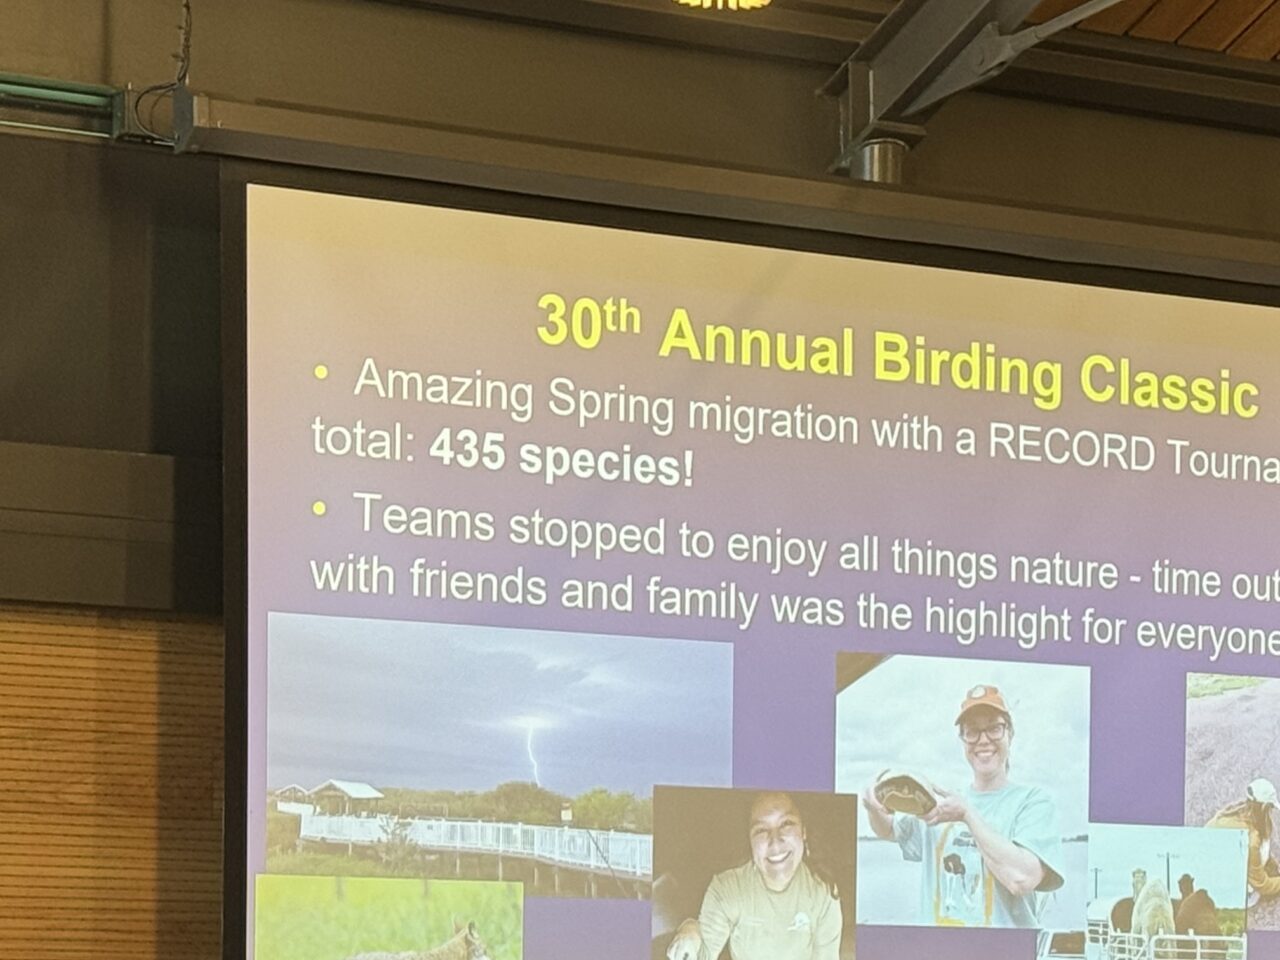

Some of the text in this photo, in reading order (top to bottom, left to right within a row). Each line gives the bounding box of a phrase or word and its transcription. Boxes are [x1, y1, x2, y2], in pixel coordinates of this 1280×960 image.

[537, 292, 1260, 419] 30th Annual Birding Classic
[311, 418, 694, 488] total: 435 species!
[354, 358, 534, 423] Amazing
[548, 376, 676, 436] Spring
[688, 394, 859, 446] migration
[871, 413, 944, 454] with
[955, 429, 977, 457] a
[989, 422, 1156, 473] RECORD
[353, 492, 495, 542] Teams
[509, 508, 666, 560] stopped
[679, 521, 715, 559] to
[726, 528, 828, 577] enjoy
[839, 535, 879, 573] all
[891, 538, 998, 590] things
[1010, 550, 1119, 590] nature
[1152, 558, 1222, 598] time
[310, 555, 395, 596] with
[410, 561, 547, 607] friends
[561, 575, 633, 613] and
[646, 577, 759, 630] family
[771, 596, 845, 627] was
[857, 591, 913, 631] the
[925, 597, 1073, 650] highlight
[1081, 607, 1126, 646] for
